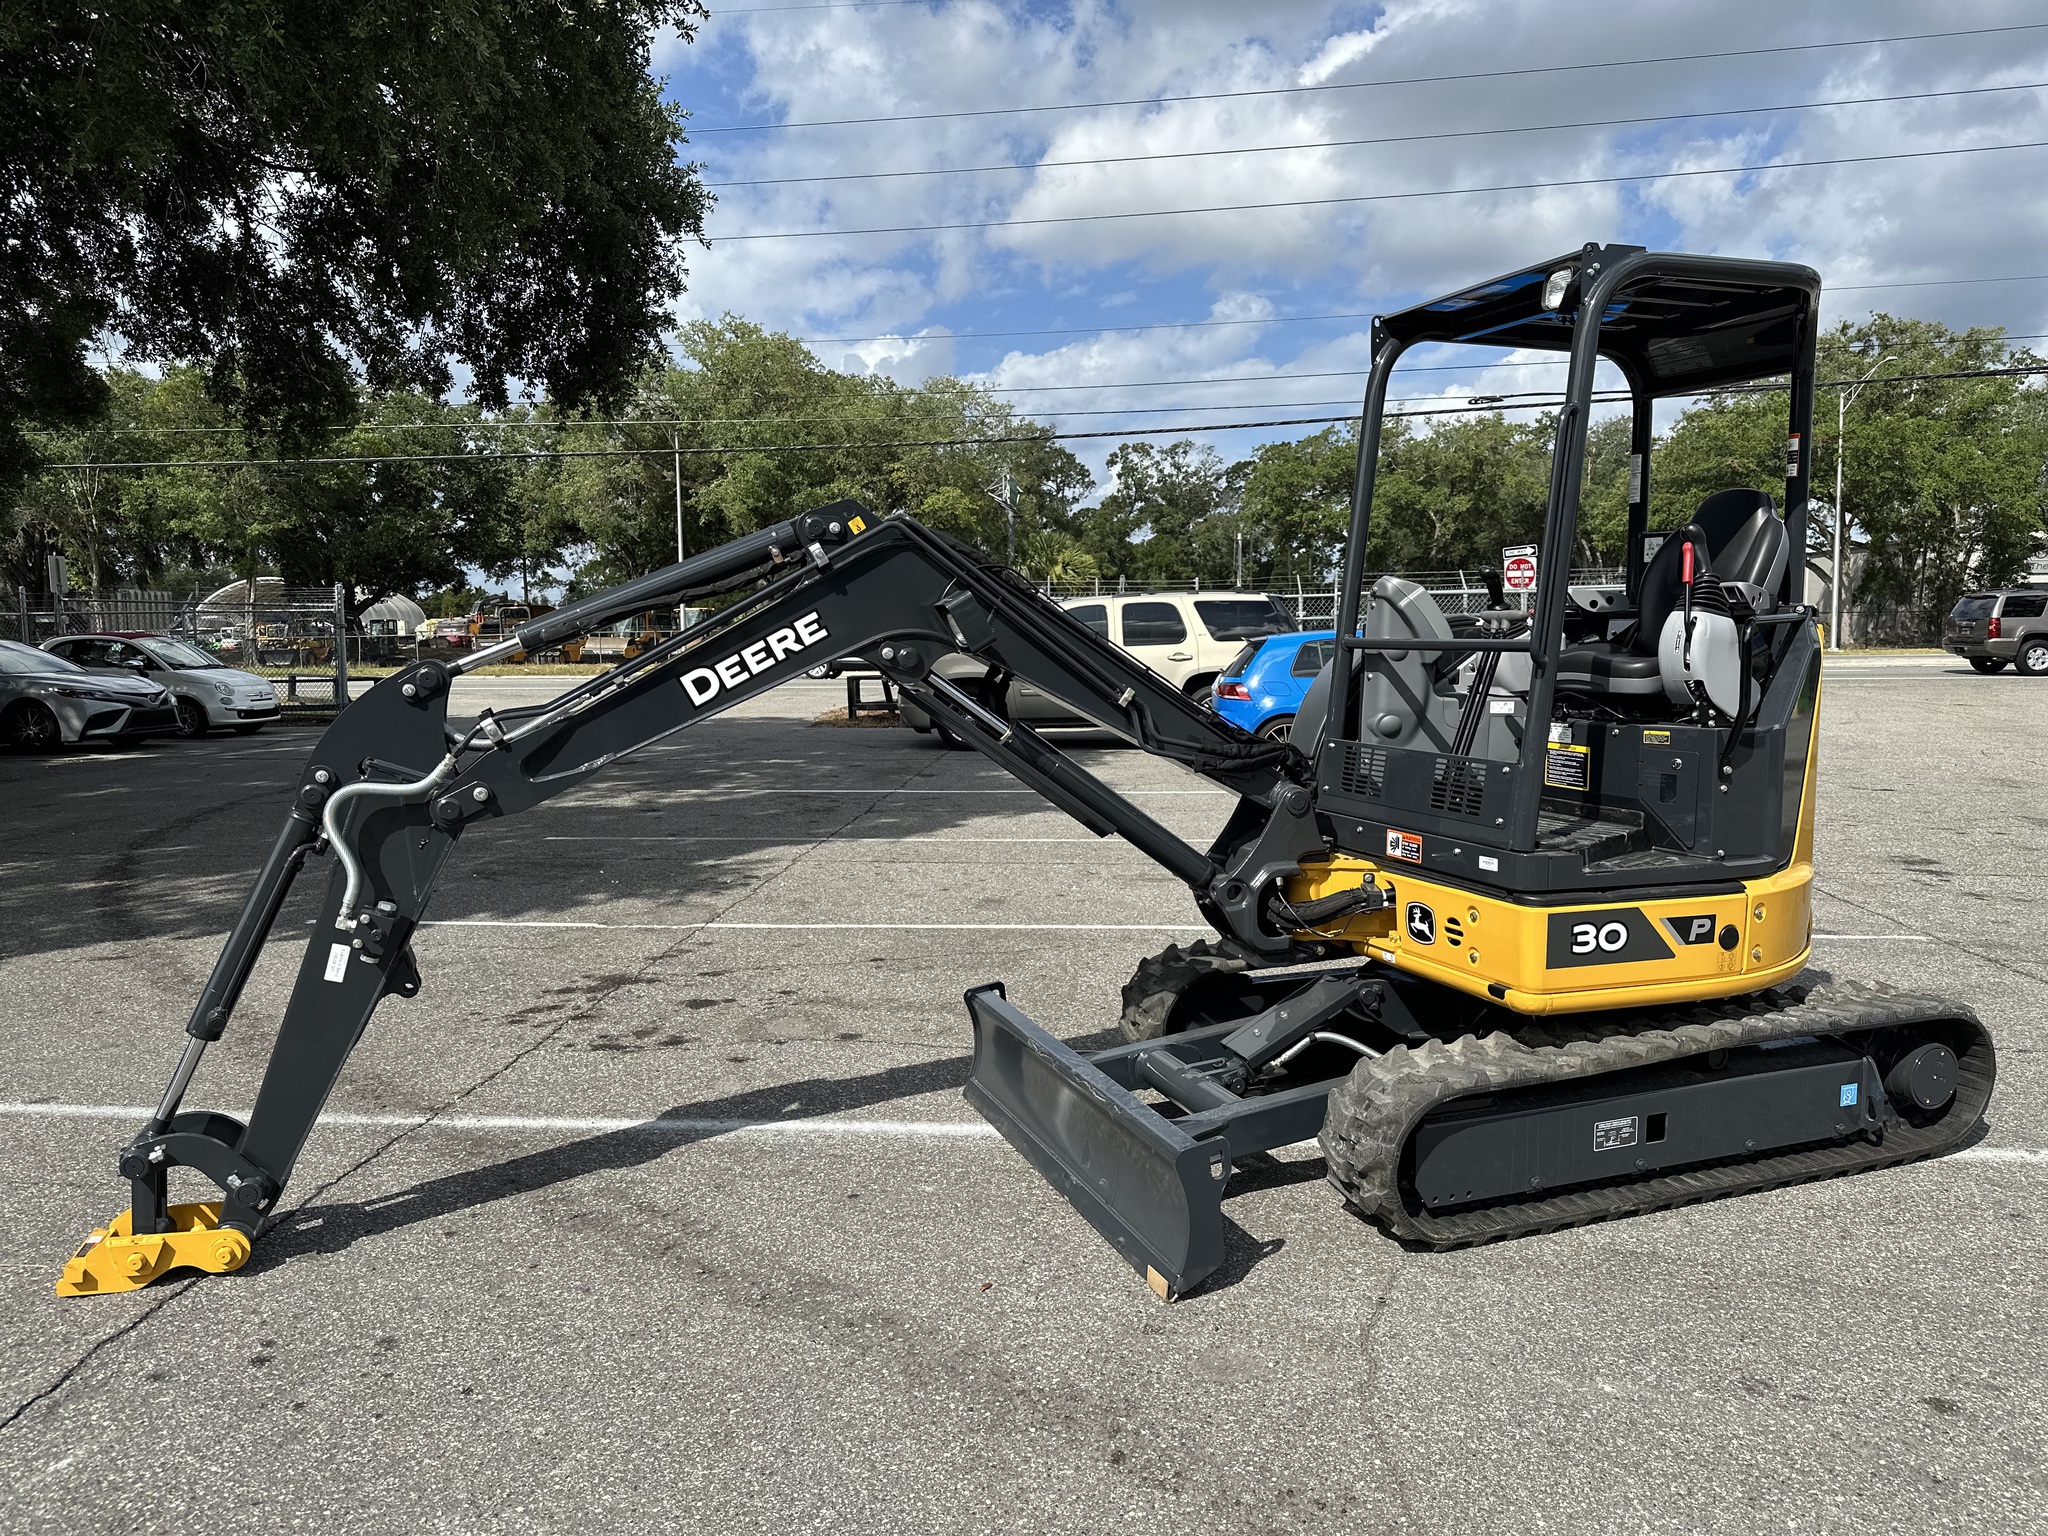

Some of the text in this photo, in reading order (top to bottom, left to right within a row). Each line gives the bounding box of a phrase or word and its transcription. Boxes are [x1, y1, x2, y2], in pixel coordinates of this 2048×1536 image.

[679, 611, 829, 707] DEERE
[1572, 918, 1712, 953] 30 P
